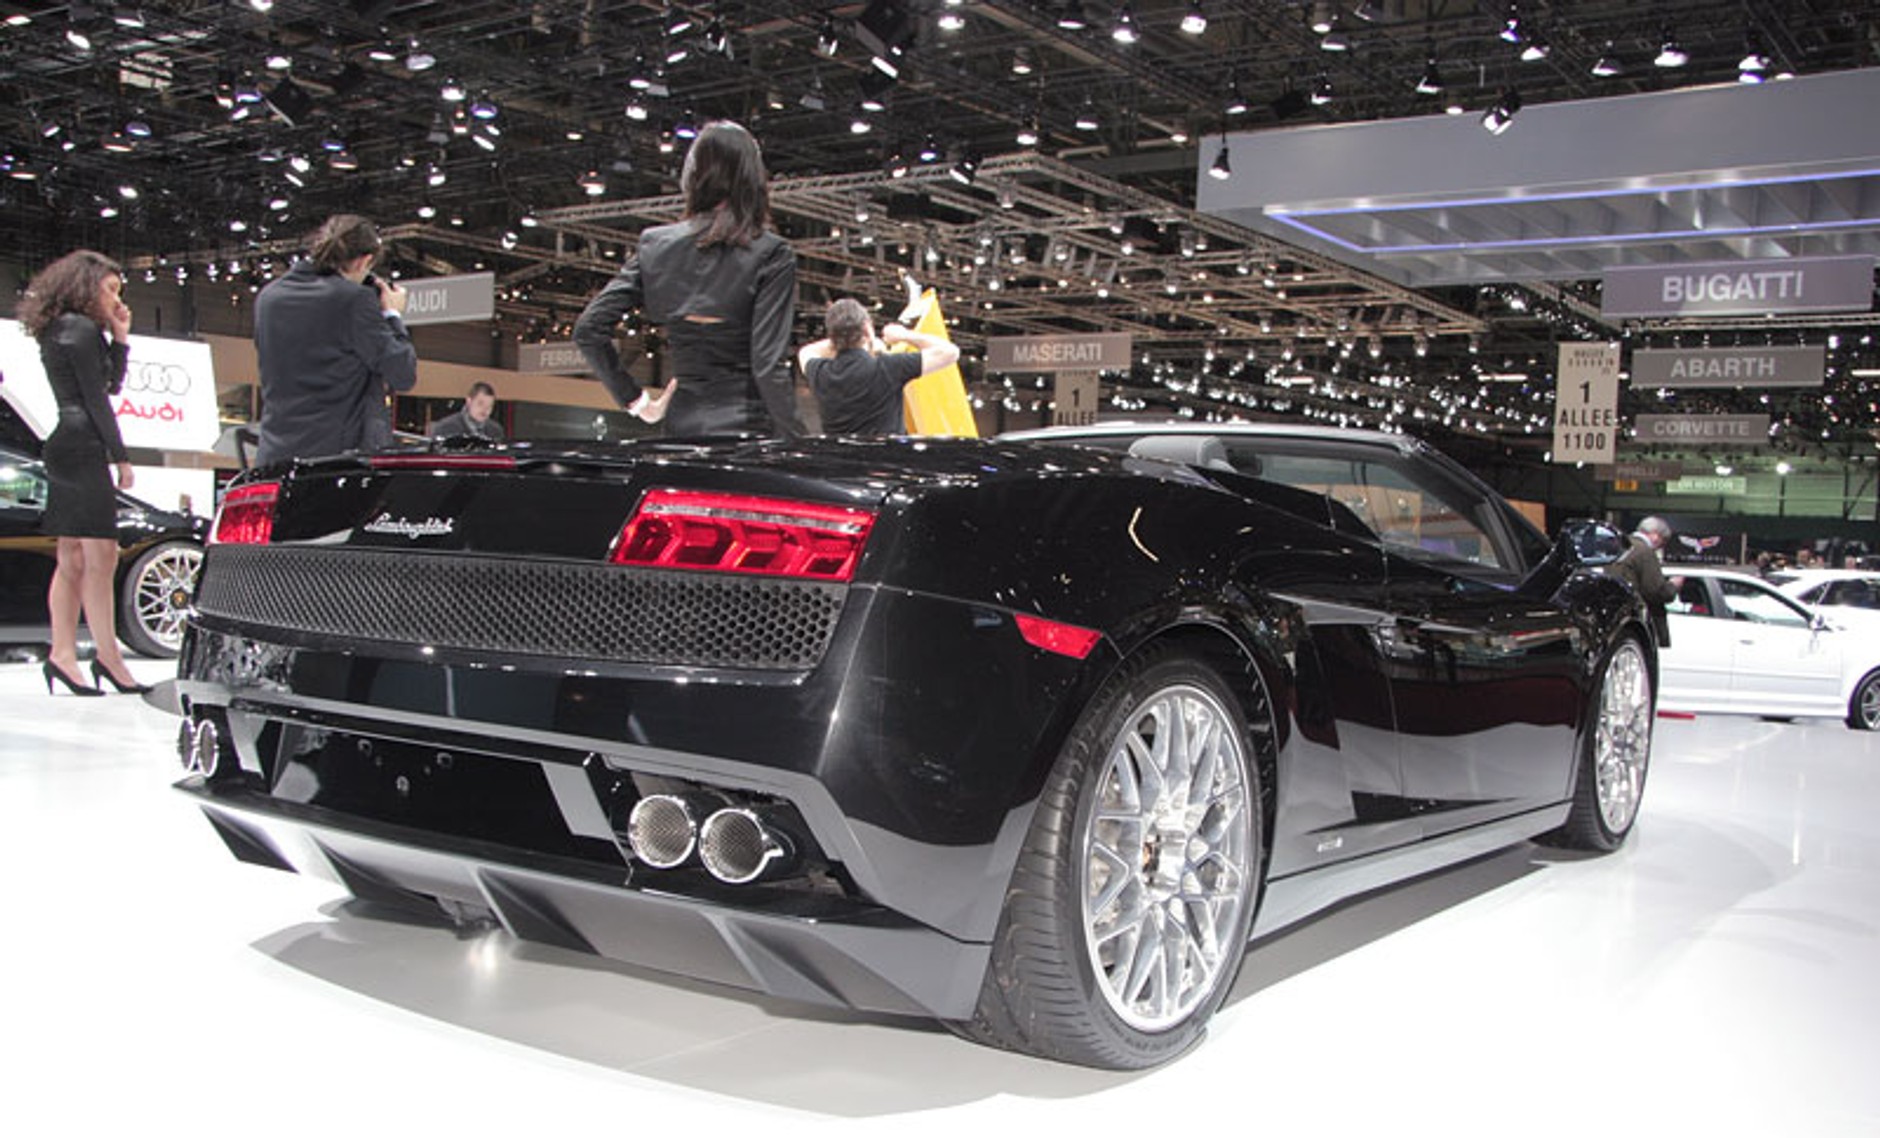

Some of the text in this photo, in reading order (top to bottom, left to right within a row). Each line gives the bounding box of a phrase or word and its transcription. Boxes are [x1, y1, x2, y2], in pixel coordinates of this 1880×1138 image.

[1662, 270, 1804, 303] BUGATTI
[406, 289, 447, 312] AUDI
[1012, 343, 1102, 364] MASERATI
[1670, 357, 1776, 379] ABARTH
[1072, 388, 1080, 407] 1
[1579, 381, 1590, 404] 1
[116, 398, 184, 422] Audi
[1559, 408, 1613, 427] ALLEE
[1653, 420, 1749, 437] CORVETTE
[1563, 432, 1606, 450] 1100
